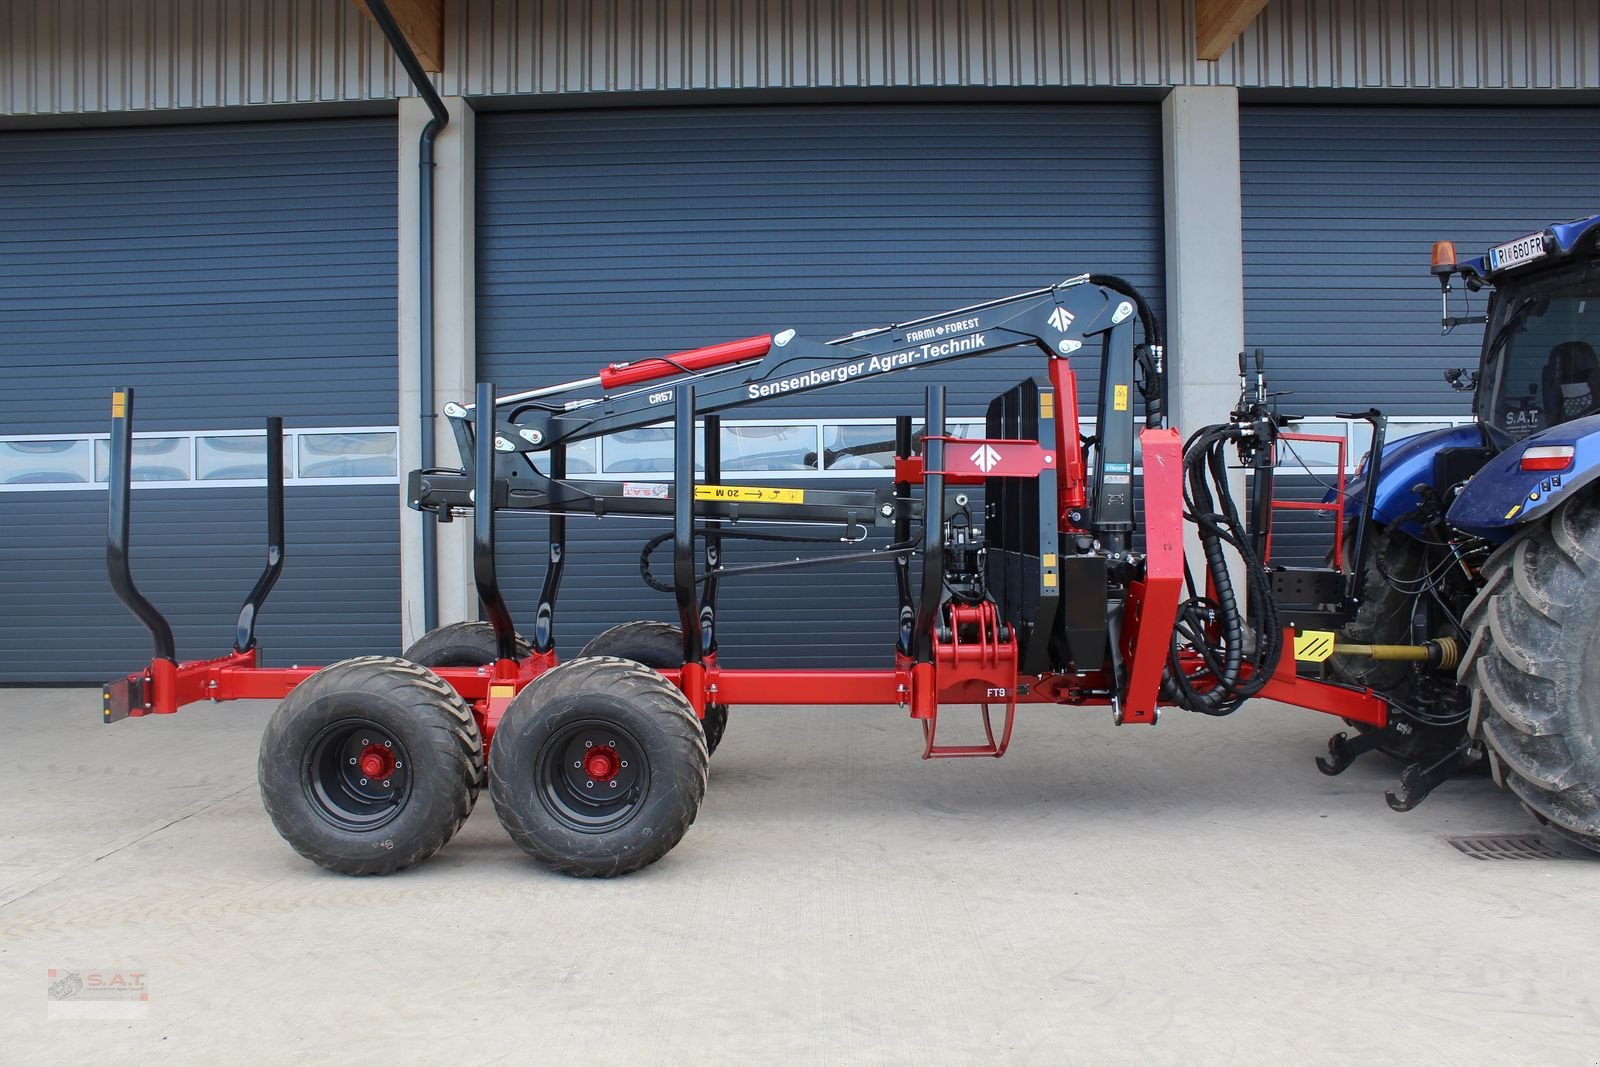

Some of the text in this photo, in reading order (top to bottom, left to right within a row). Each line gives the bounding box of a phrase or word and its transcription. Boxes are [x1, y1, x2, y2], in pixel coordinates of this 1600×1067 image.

[1498, 248, 1508, 264] RI
[906, 317, 979, 343] FARMI FOREST
[748, 334, 985, 399] Sensenberger Agrar-Technik
[648, 390, 673, 405] CR57
[1506, 410, 1538, 424] S.A.T.
[716, 489, 739, 497] 20 M
[987, 688, 1005, 697] FT9
